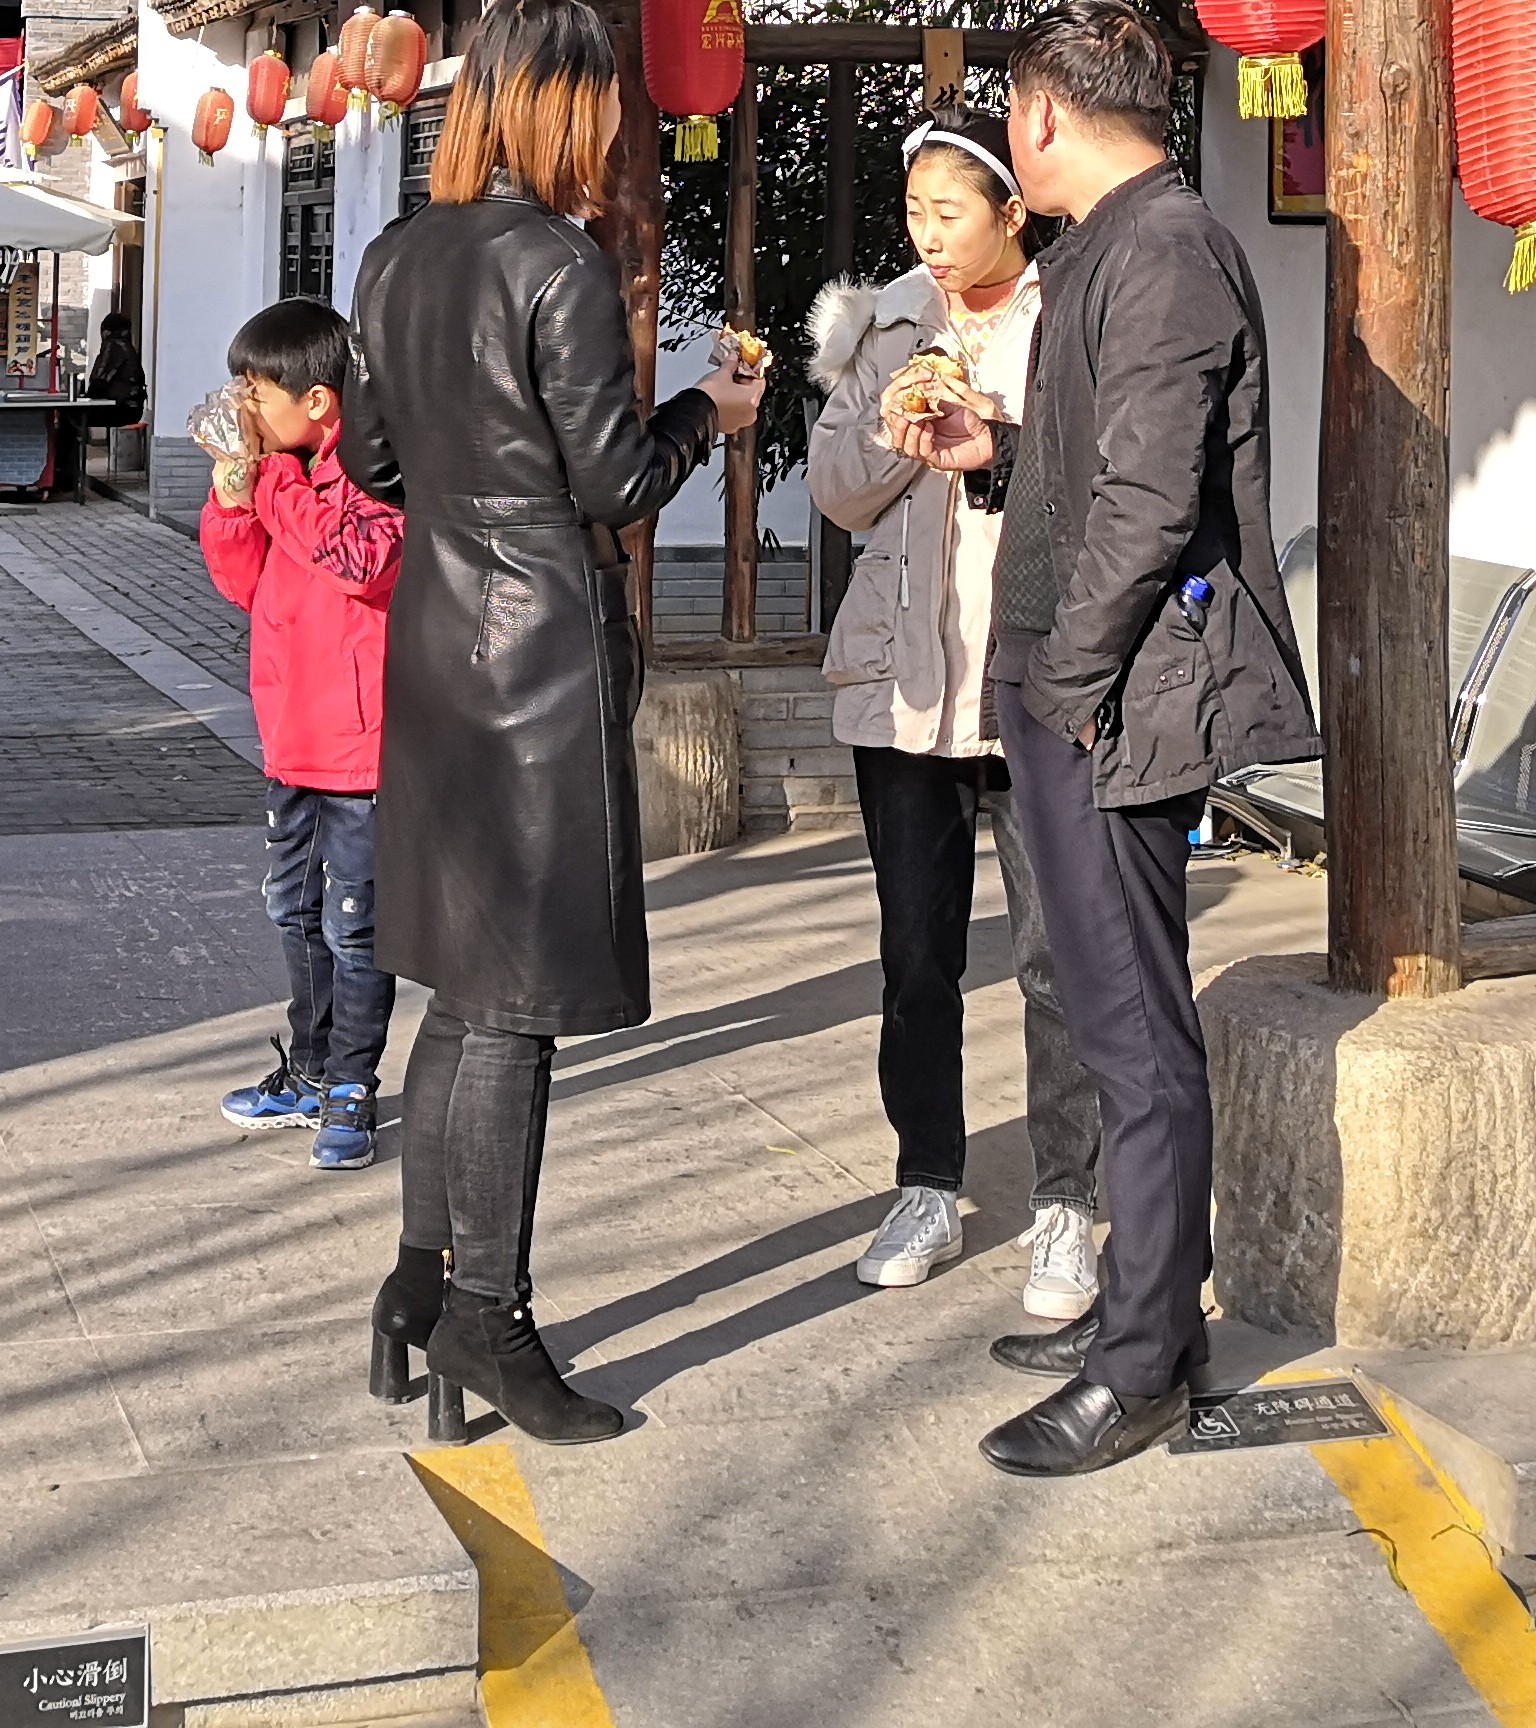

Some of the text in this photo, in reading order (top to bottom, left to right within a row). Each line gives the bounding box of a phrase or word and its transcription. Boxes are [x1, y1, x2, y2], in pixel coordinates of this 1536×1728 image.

[1254, 1393, 1357, 1415] 无障碍通道
[23, 1657, 129, 1695] 小心滑倒
